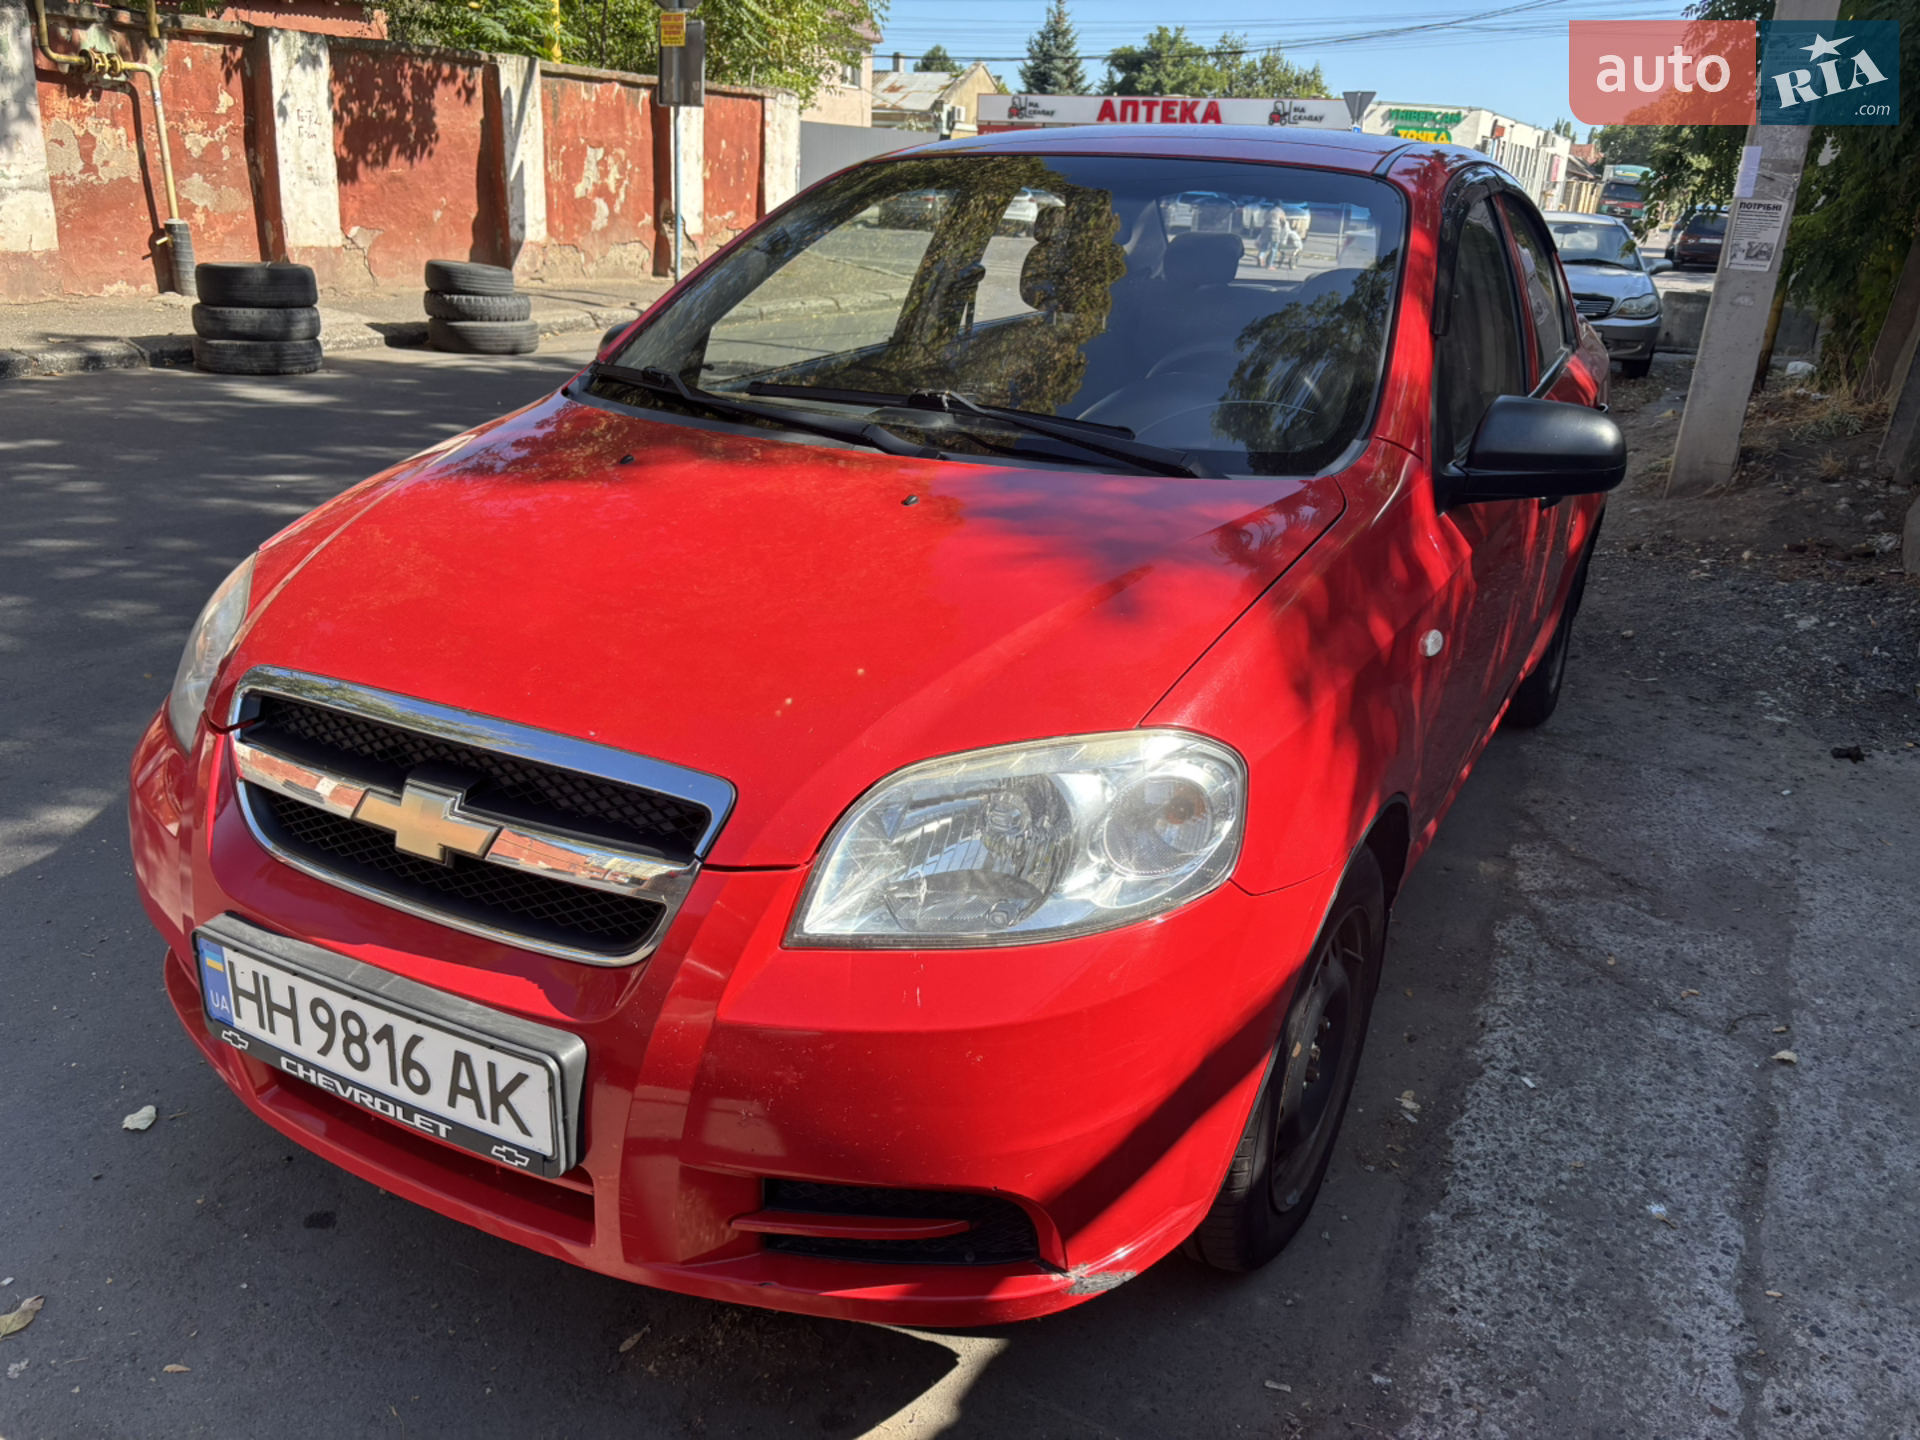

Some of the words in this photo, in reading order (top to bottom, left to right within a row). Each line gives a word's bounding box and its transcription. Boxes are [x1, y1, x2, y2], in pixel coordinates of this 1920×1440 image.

[1096, 99, 1222, 124] АПТЕКА
[1389, 108, 1462, 124] УНІВЕРСАМ
[1397, 130, 1451, 144] ТОЧКА
[1739, 202, 1783, 211] ПОТРІБНІ
[210, 989, 231, 1014] UA
[228, 960, 302, 1047] HH
[309, 997, 431, 1095] 9816
[447, 1050, 534, 1138] AK
[280, 1056, 453, 1138] CHEVROLET
